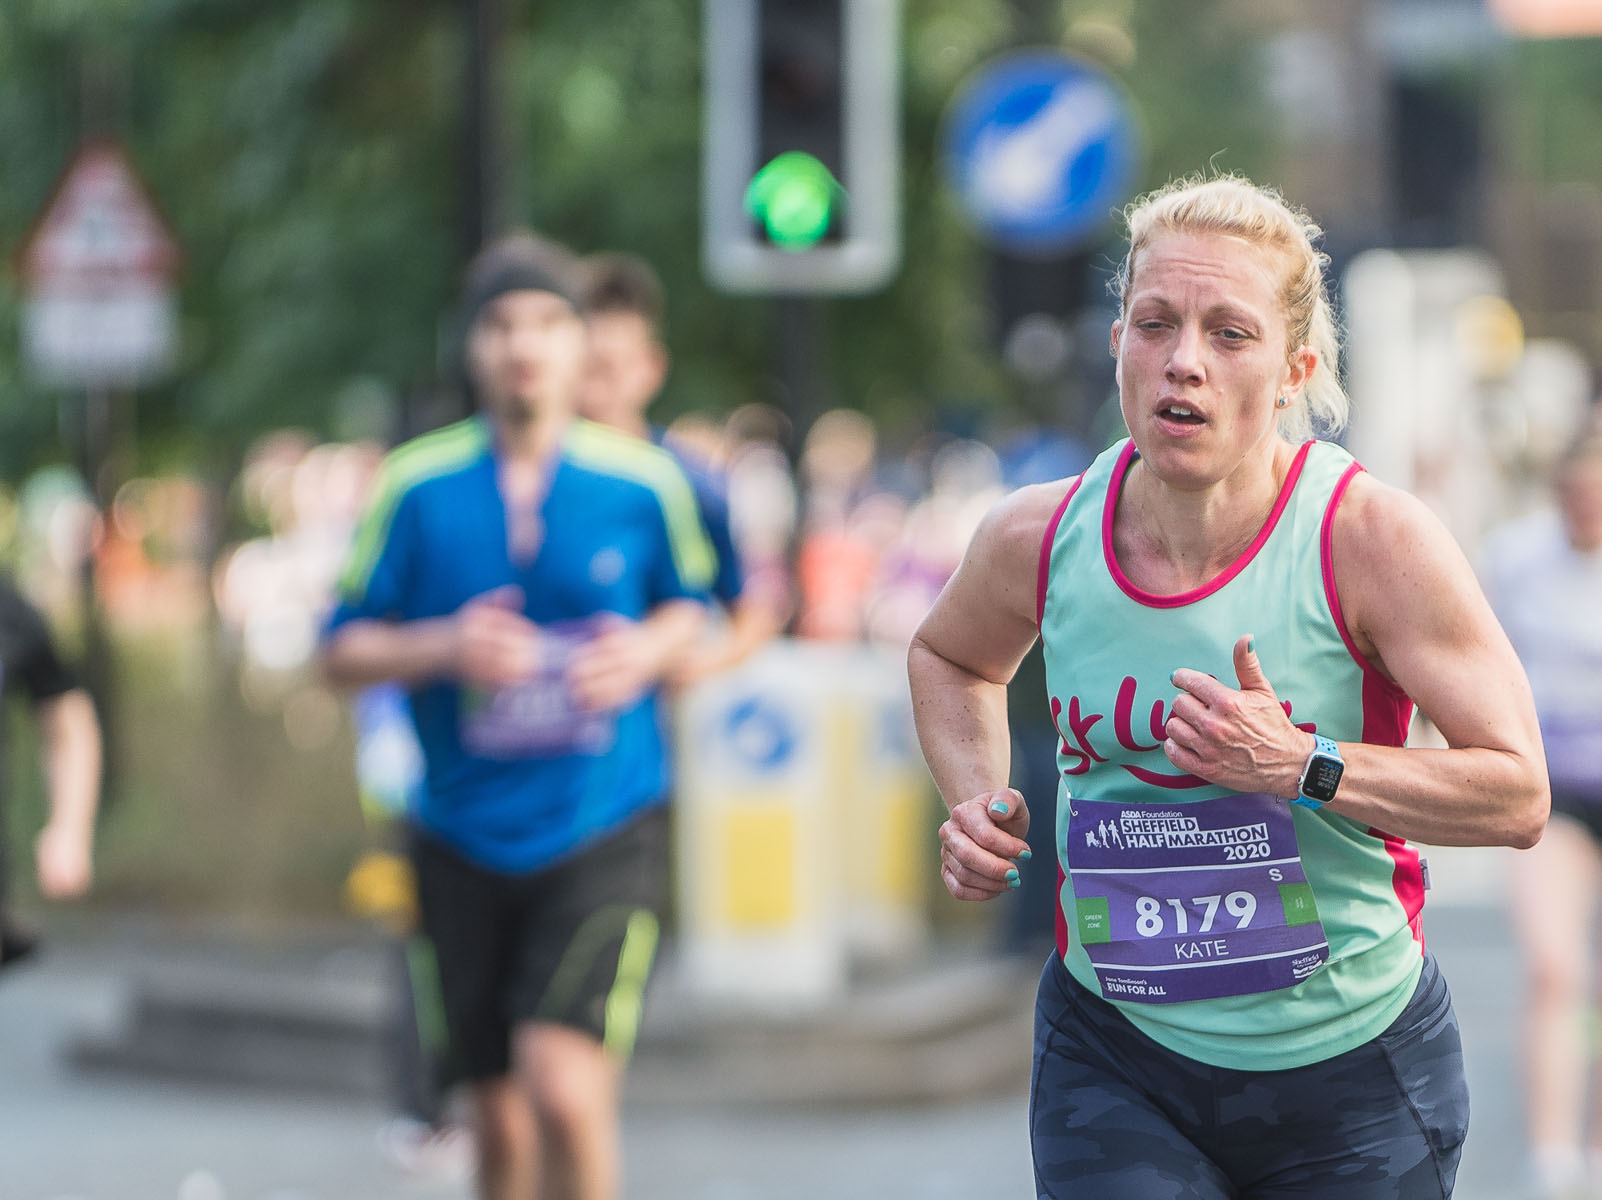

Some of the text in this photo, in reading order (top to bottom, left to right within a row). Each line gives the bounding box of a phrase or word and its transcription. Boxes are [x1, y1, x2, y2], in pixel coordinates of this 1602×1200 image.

[1122, 819, 1196, 833] SHEFFIELD
[1126, 825, 1267, 848] HALF MARATHON
[1223, 842, 1271, 860] 2020
[1269, 868, 1283, 881] S
[1135, 890, 1258, 938] 8179
[1174, 939, 1230, 960] KATE
[1291, 953, 1320, 966] Sheffield
[1107, 982, 1167, 996] RUN FOR ALL
